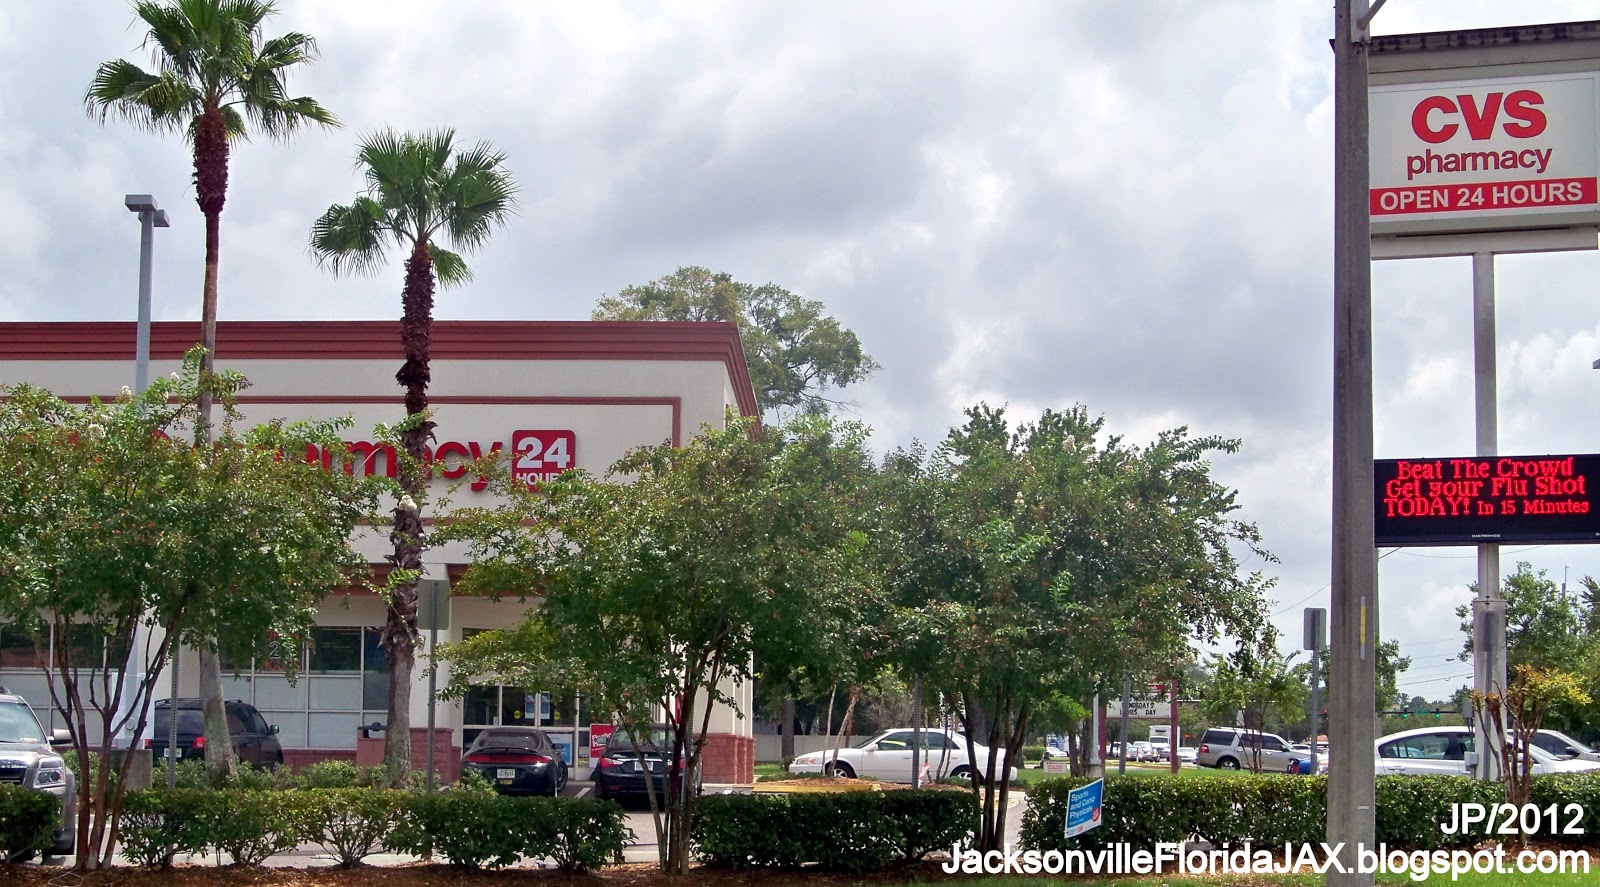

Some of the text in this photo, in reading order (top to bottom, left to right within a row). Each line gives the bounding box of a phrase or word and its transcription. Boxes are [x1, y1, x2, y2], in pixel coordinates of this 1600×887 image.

[1411, 89, 1547, 143] CVS
[1407, 148, 1553, 181] pharmacy
[1380, 182, 1583, 211] OPEN 24 HOURS
[516, 437, 571, 469] 24
[1397, 457, 1574, 480] Beat The Crowd
[1386, 475, 1587, 498] Get your Flu Shot
[1384, 497, 1590, 517] TODAY! In 15 Minutes
[1070, 796, 1096, 811] and Camp
[1071, 790, 1089, 802] Sports
[1069, 805, 1093, 819] Physicals
